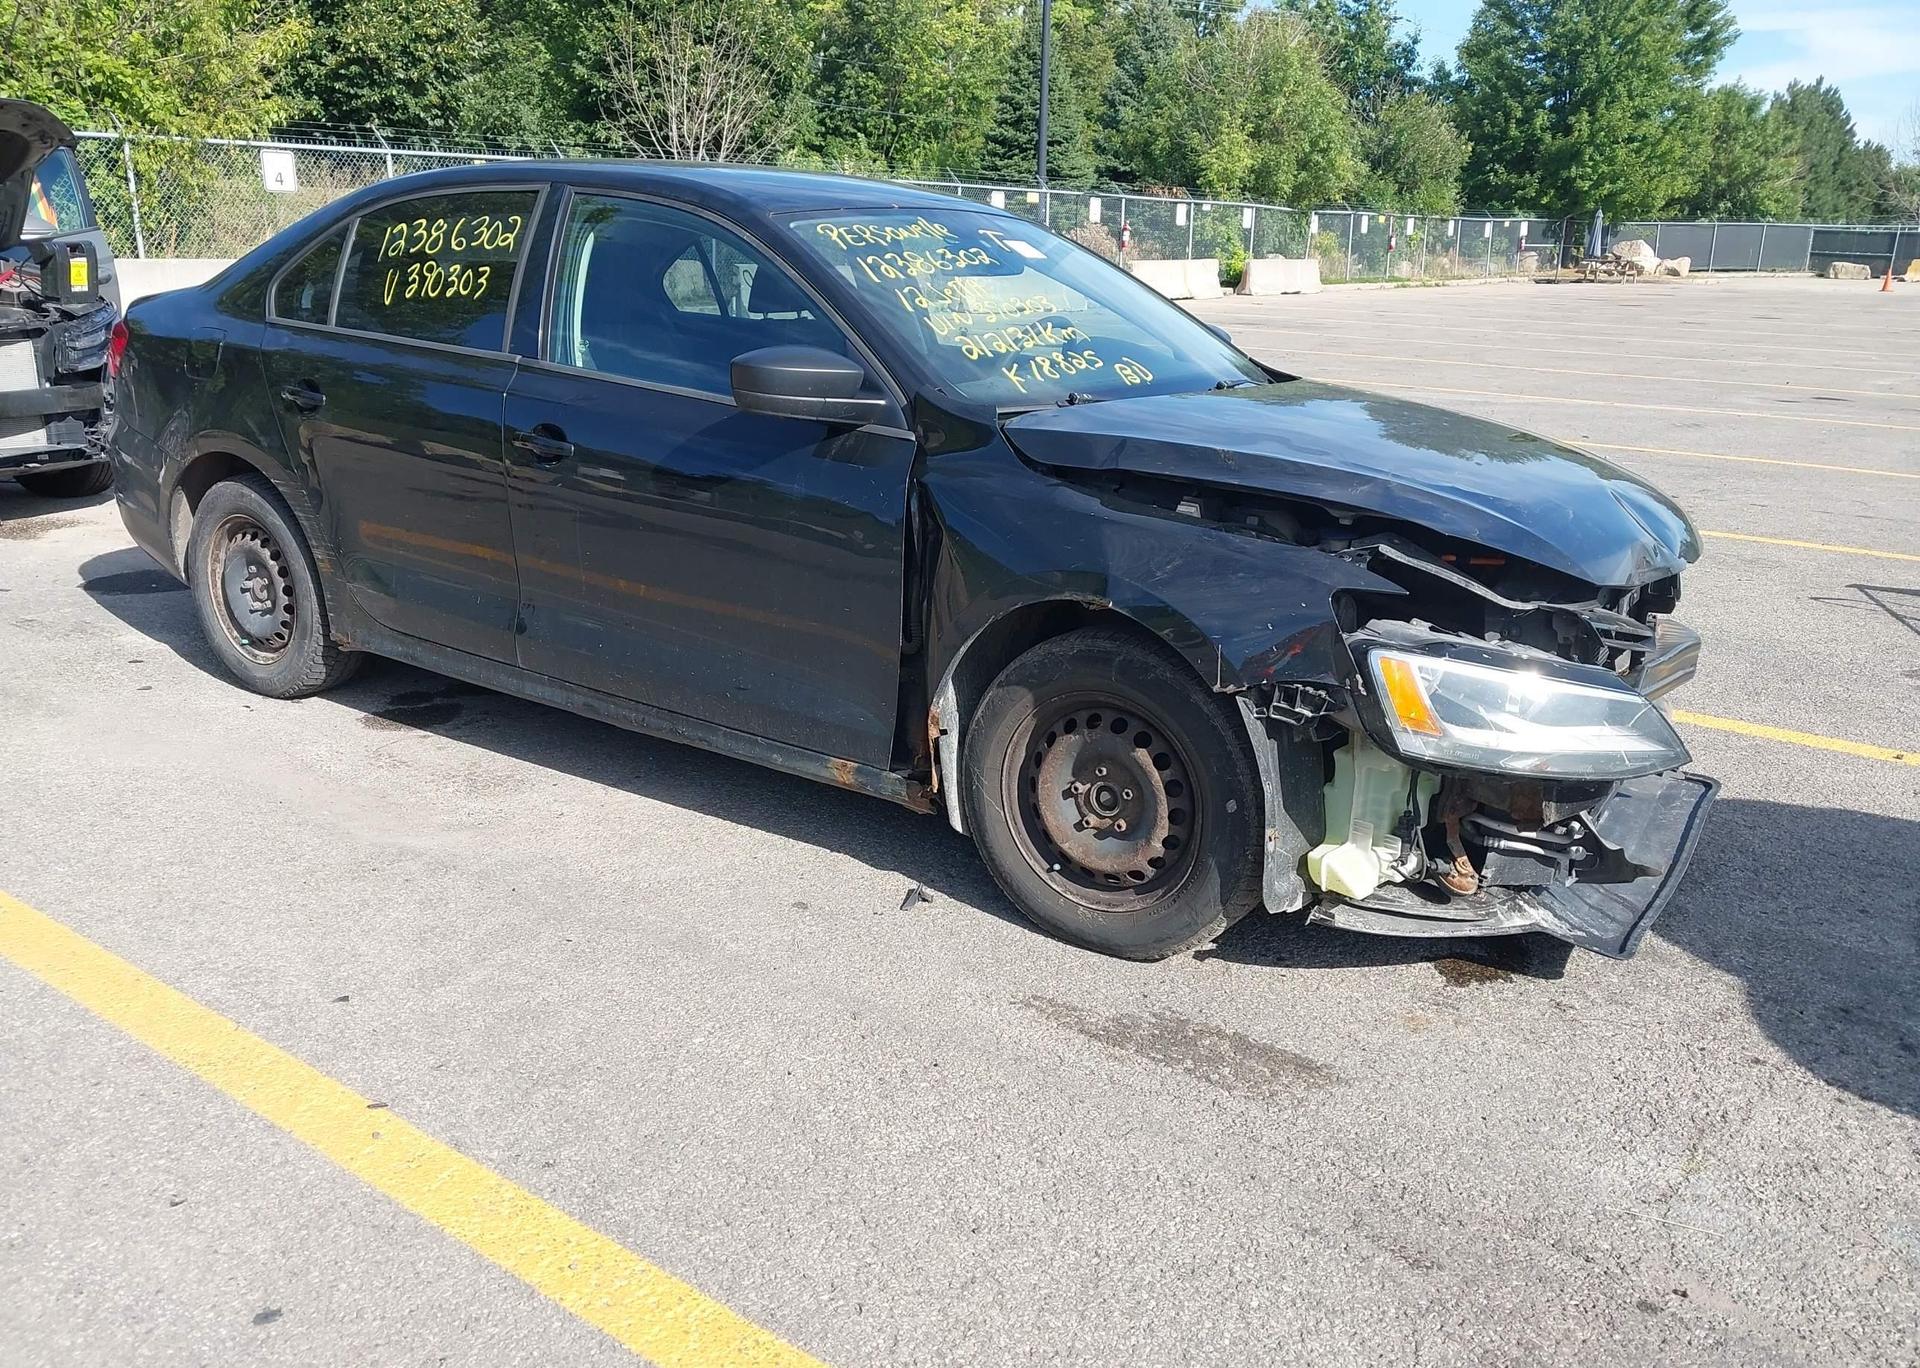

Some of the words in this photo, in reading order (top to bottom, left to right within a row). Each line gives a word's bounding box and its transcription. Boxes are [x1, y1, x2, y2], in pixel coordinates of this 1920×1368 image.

[275, 172, 284, 186] 4
[378, 215, 521, 262] 12386302
[405, 260, 490, 300] 390303
[856, 247, 1000, 283] 12386302
[895, 286, 930, 313] 12
